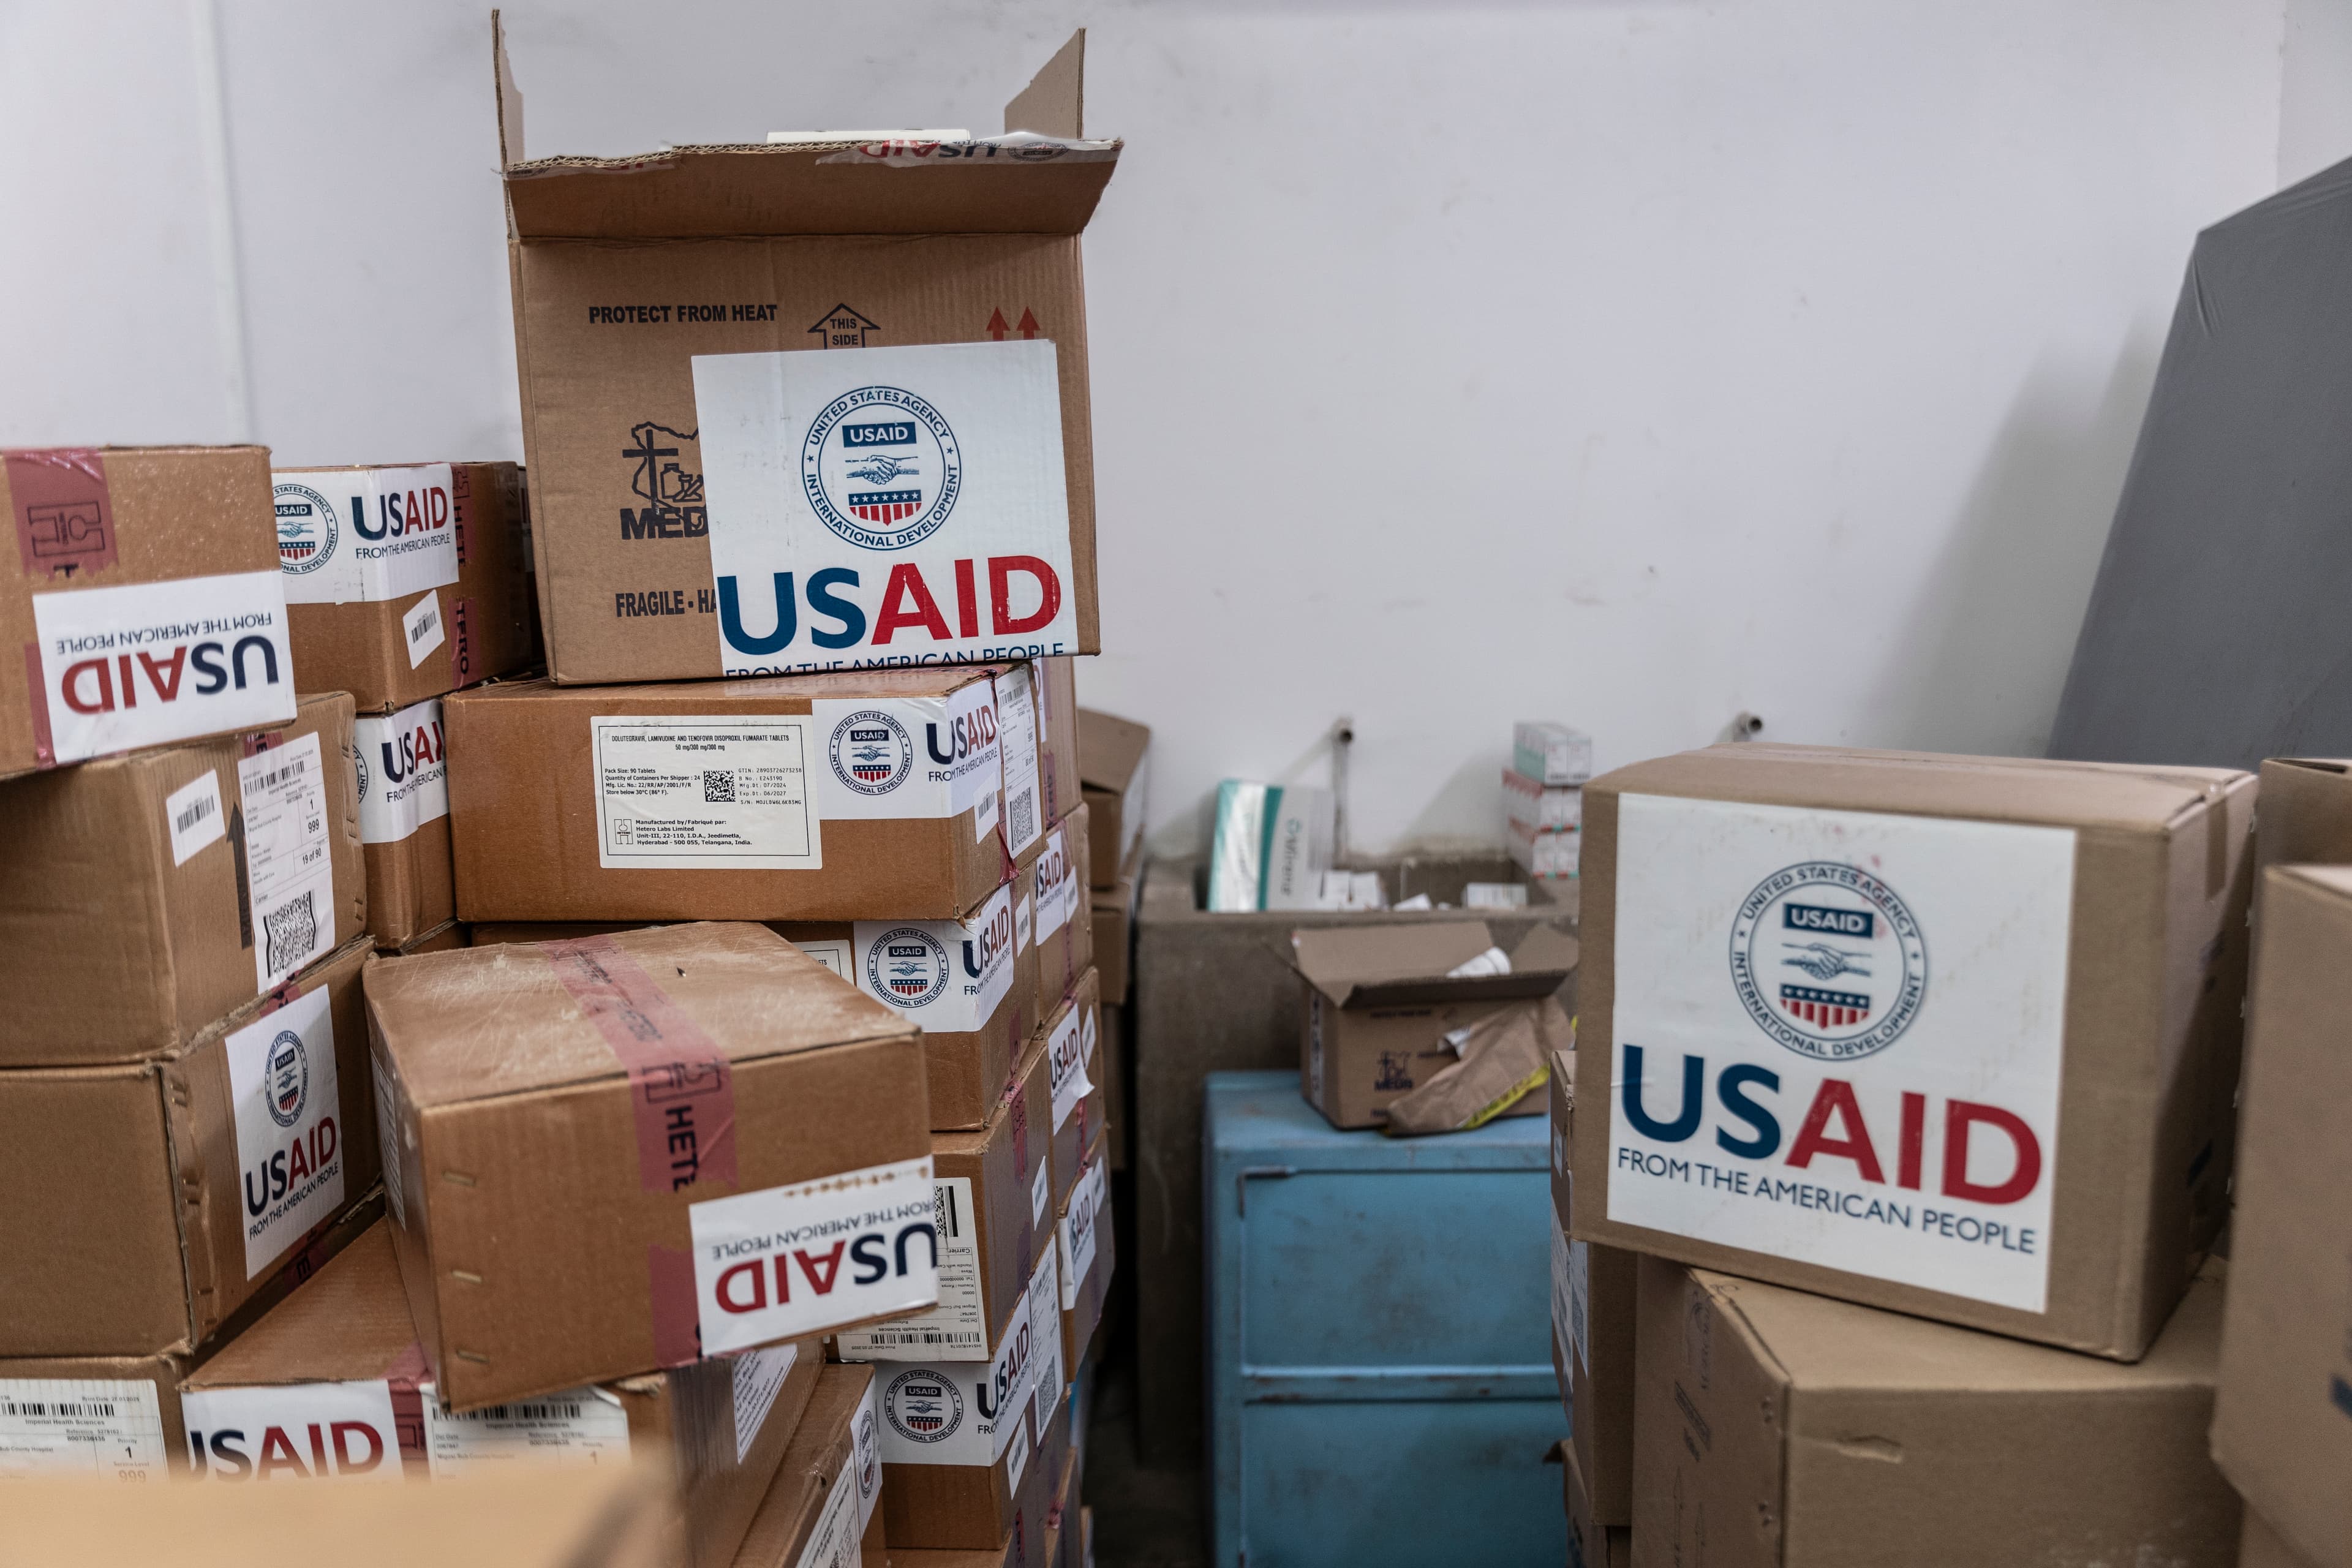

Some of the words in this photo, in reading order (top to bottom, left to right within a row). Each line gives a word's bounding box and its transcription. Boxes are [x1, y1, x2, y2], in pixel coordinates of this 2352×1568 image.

[589, 306, 671, 324] PROTECT
[677, 305, 727, 322] FROM
[733, 304, 777, 322] HEAT
[830, 318, 857, 329] THIS
[832, 334, 858, 345] SIDE
[810, 401, 848, 446] UNITED
[850, 391, 900, 405] STATES
[901, 396, 949, 439] AGENCY
[850, 426, 908, 442] USAID
[276, 506, 308, 514] USAID
[303, 489, 331, 514] AGENCY
[351, 486, 448, 541] USAID
[807, 473, 894, 547] INTERNATIONAL
[897, 464, 957, 545] DEVELOPMENT
[301, 528, 336, 571] DEVELOPMENT
[355, 547, 388, 560] FROM
[388, 543, 400, 556] THE
[400, 537, 430, 554] AMERICAN
[431, 533, 450, 547] PEOPLE
[616, 590, 685, 617] FRAGILE
[717, 555, 1062, 655] USAID
[119, 621, 199, 645] AMERICAN
[203, 620, 232, 635] THE
[233, 612, 273, 628] FROM
[57, 635, 115, 655] PEOPLE
[855, 650, 974, 669] AMERICAN
[982, 643, 1064, 662] PEOPLE
[61, 635, 279, 715] USAID
[834, 718, 854, 741] UNITED
[881, 716, 907, 739] AGENCY
[926, 705, 997, 765] USAID
[381, 720, 443, 784] USAI
[929, 769, 956, 782] FROM
[956, 765, 965, 778] THE
[965, 754, 985, 774] AMERICAN
[985, 747, 998, 764] PEOPLE
[832, 754, 876, 793] INTERNATIONAL
[877, 752, 911, 793] DEVELOPMENT
[309, 798, 314, 810] 1
[386, 788, 407, 803] FROM
[308, 818, 319, 834] 999
[303, 854, 308, 865] 19
[309, 851, 315, 862] of
[315, 847, 322, 858] 90
[255, 894, 268, 904] Carrier
[1743, 873, 1793, 921] UNITED
[1796, 865, 1860, 885] STATES
[1860, 881, 1917, 940] AGENCY
[1790, 907, 1865, 933] USAID
[872, 934, 892, 956] UNITED
[919, 933, 944, 955] AGENCY
[962, 905, 1009, 979] USAID
[870, 968, 913, 1006] INTERNATIONAL
[914, 967, 947, 1006] DEVELOPMENT
[964, 979, 983, 995] FROM
[1733, 951, 1828, 1056] INTERNATIONAL
[1831, 971, 1921, 1056] DEVELOPMENT
[276, 1053, 294, 1068] USAID
[1049, 1027, 1078, 1090] USAID
[1621, 1044, 2042, 1206] USAID
[246, 1116, 336, 1216] USAID
[249, 1216, 269, 1240] FROM
[268, 1204, 282, 1224] THE
[282, 1180, 315, 1215] AMERICAN
[317, 1161, 339, 1187] PEOPLE
[1617, 1147, 1690, 1183] FROM
[1694, 1164, 1749, 1194] THE
[1754, 1177, 1912, 1229] AMERICAN
[1921, 1208, 2037, 1254] PEOPLE
[777, 1213, 862, 1246] AMERICAN
[864, 1207, 894, 1226] THE
[712, 1235, 771, 1260] PEOPLE
[715, 1222, 937, 1315] USAID
[976, 1321, 1030, 1420] USAID
[889, 1375, 909, 1394] UNITED
[934, 1374, 959, 1396] AGENCY
[886, 1405, 928, 1441] INTERNATIONAL
[929, 1407, 962, 1441] DEVELOPMENT
[125, 1446, 132, 1458] 1
[119, 1469, 147, 1483] 999
